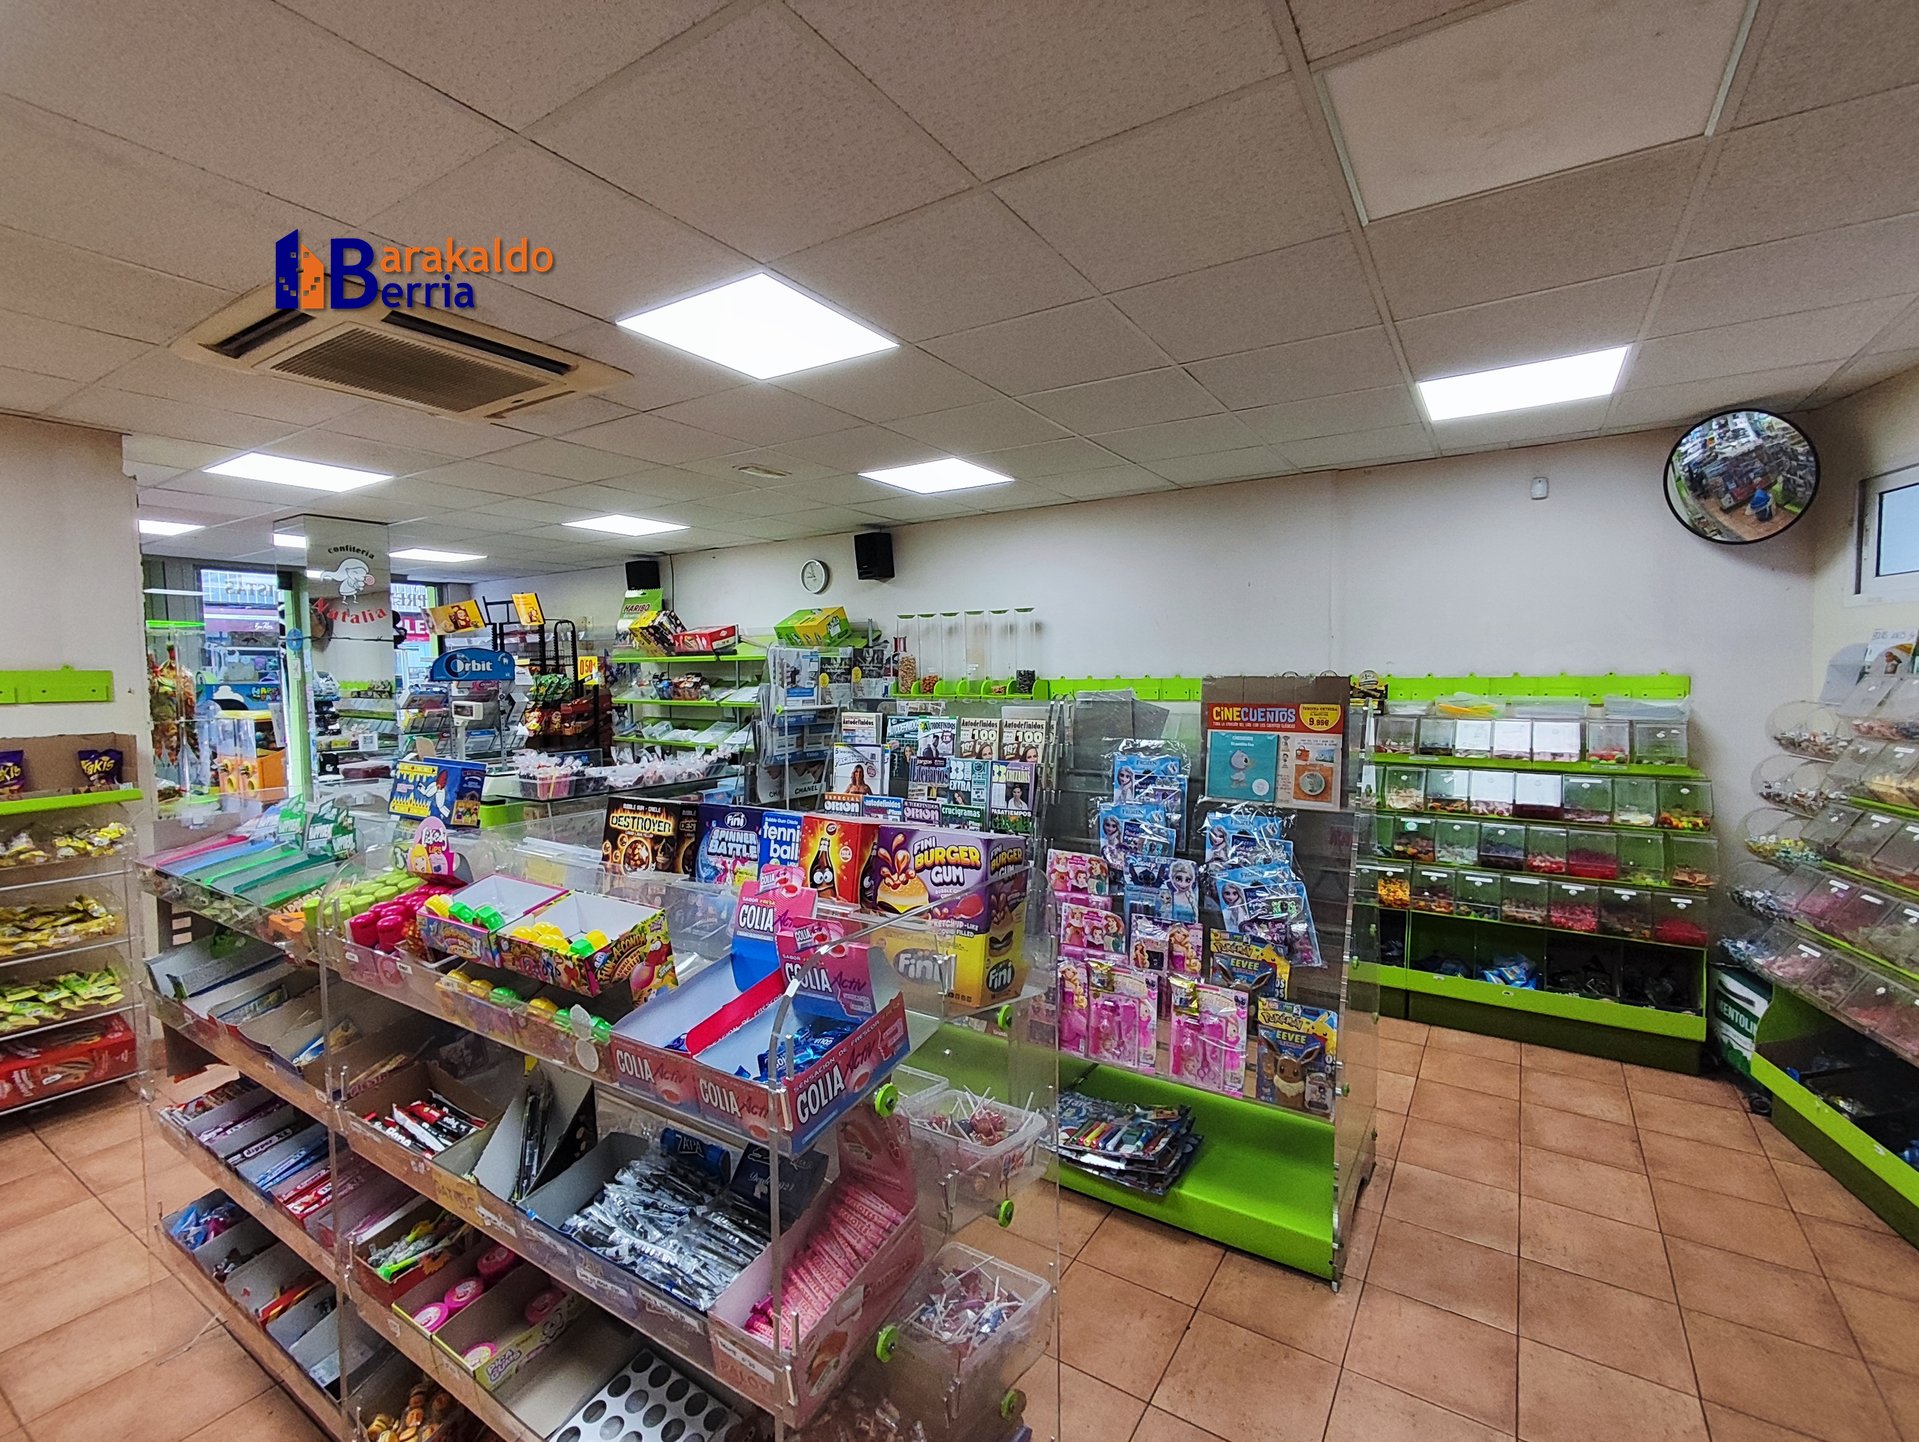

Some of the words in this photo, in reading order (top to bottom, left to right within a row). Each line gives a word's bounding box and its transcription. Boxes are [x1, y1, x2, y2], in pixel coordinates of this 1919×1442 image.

[313, 597, 388, 625] Natalia
[623, 604, 650, 613] HARIBO
[449, 658, 493, 678] Orbit
[842, 718, 874, 727] Autodefinidos
[962, 720, 998, 729] Autodefinidos
[1003, 720, 1045, 730] Autodefinidos
[972, 729, 997, 741] 100
[1015, 731, 1043, 743] 100
[795, 785, 818, 795] CHANEL
[949, 781, 971, 792] EXTRA
[824, 801, 860, 813] ORION
[941, 806, 981, 818] crucigramas
[991, 808, 1032, 817] PASATIEMPOS
[727, 813, 744, 826] Fini
[903, 810, 939, 821] ORION
[611, 814, 672, 833] DESTROYER
[711, 828, 757, 844] SPINNER
[708, 841, 758, 858] BATTLE
[914, 837, 936, 854] FINI
[913, 845, 983, 872] BURGER
[930, 866, 966, 887] GUM
[1230, 957, 1260, 971] EEVEE
[988, 964, 1013, 988] Fini
[1719, 1001, 1758, 1035] ENTOLI
[1275, 1030, 1307, 1045] EEVEE
